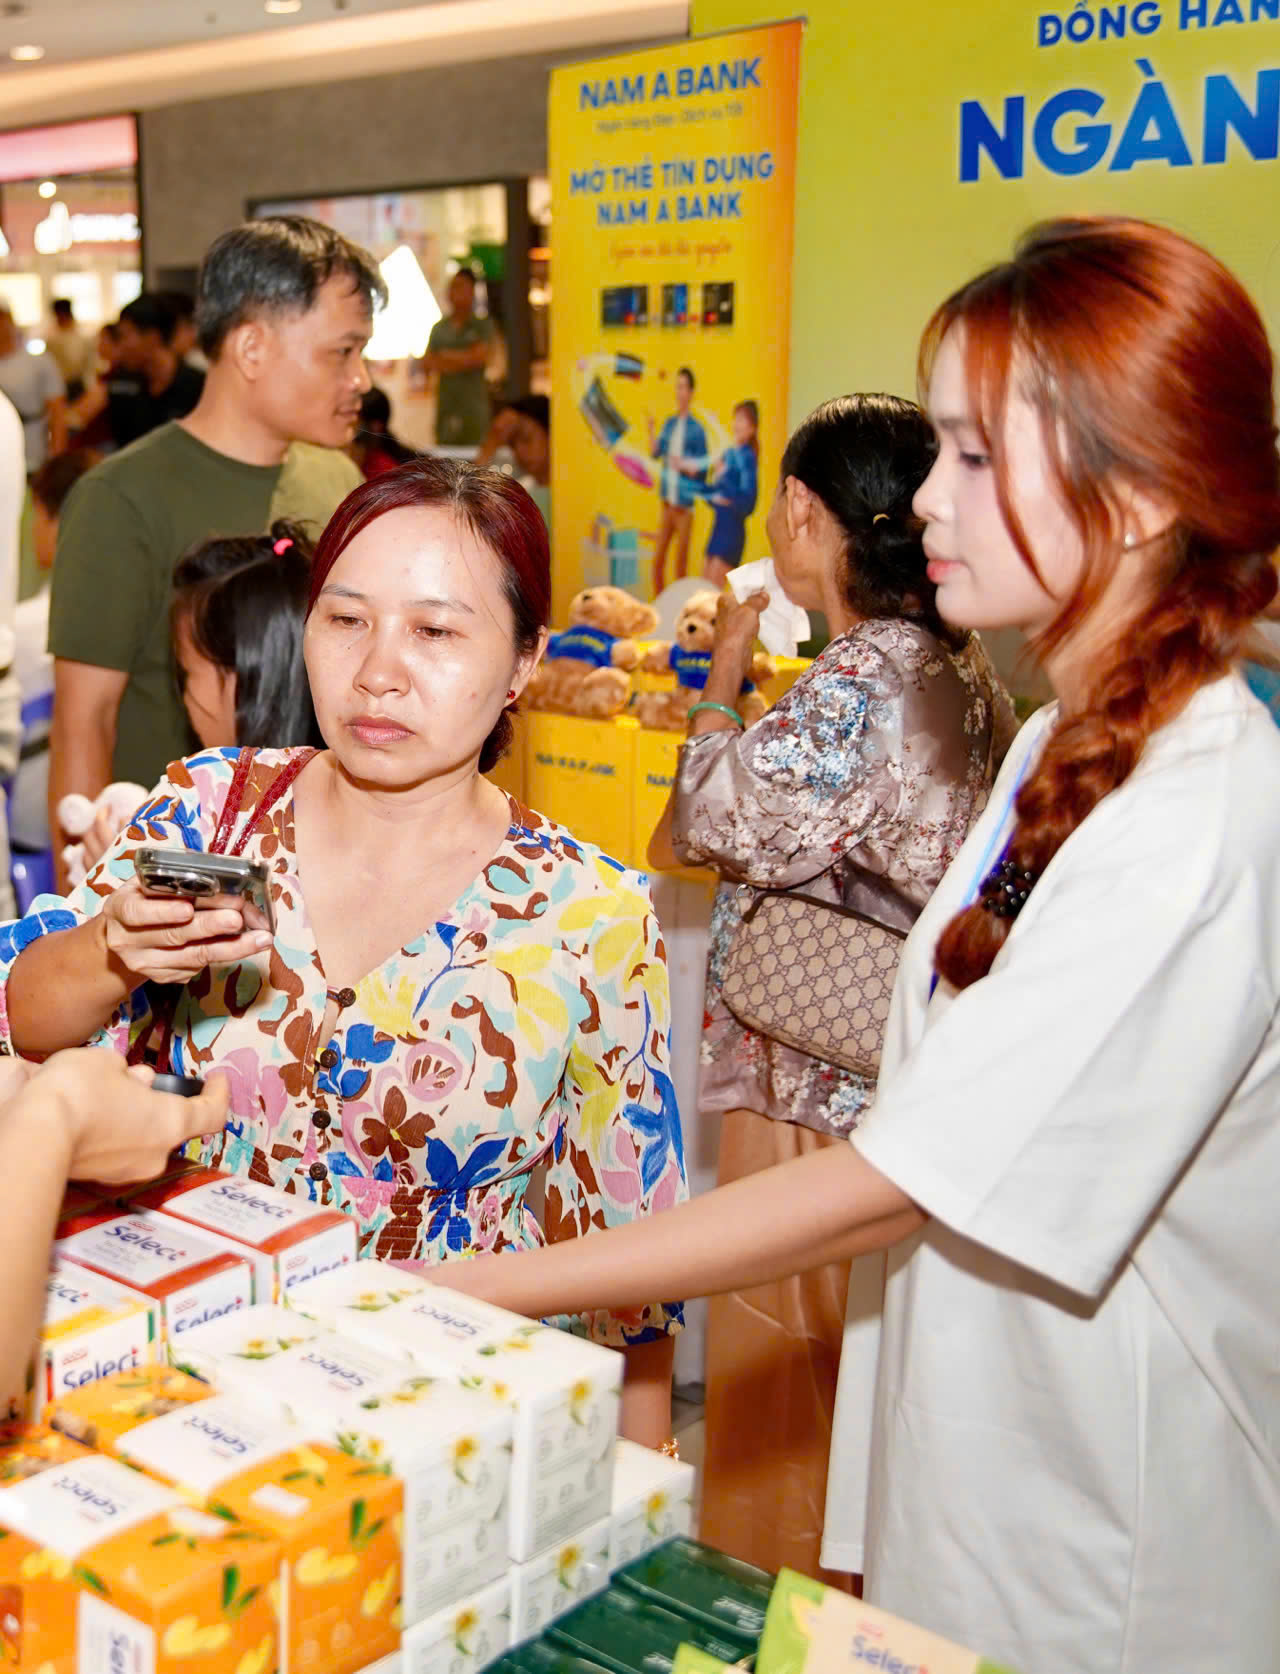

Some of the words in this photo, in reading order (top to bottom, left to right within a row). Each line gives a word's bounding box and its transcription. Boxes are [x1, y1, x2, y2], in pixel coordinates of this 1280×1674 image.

[580, 74, 646, 110] NAM
[652, 72, 671, 102] A
[676, 57, 762, 97] BANK
[959, 57, 1280, 183] NGÀN
[597, 198, 648, 226] NAM
[656, 198, 670, 224] A
[677, 191, 742, 222] BANK
[210, 1185, 293, 1219] Select
[103, 1225, 187, 1261] Select
